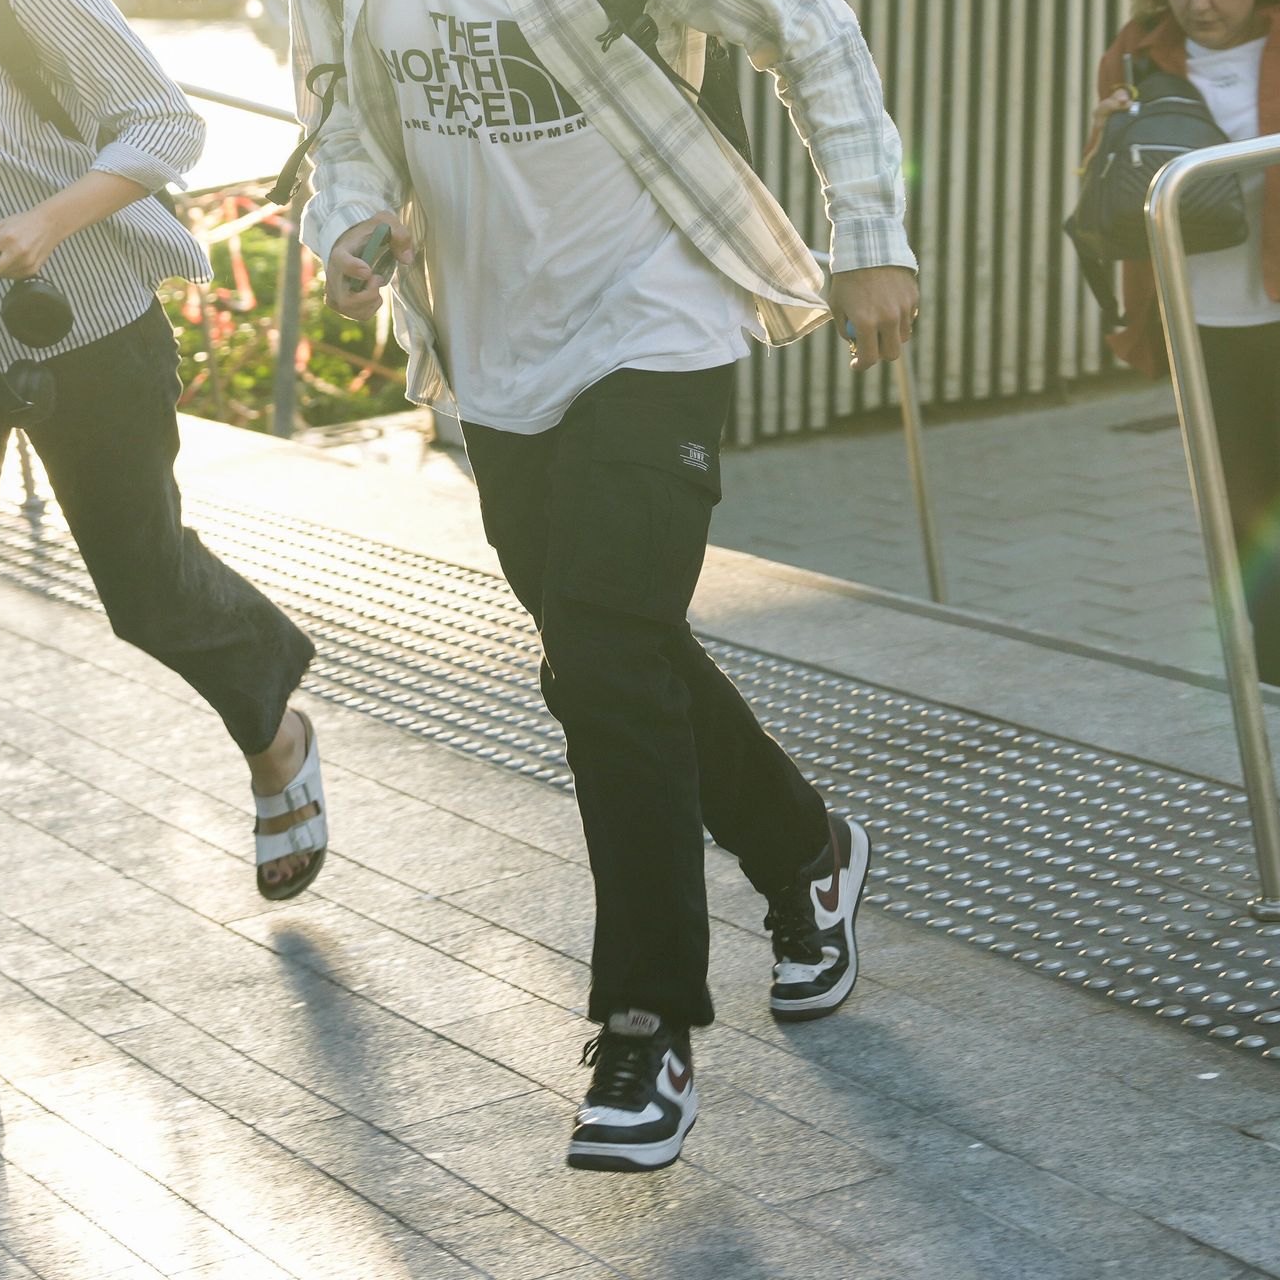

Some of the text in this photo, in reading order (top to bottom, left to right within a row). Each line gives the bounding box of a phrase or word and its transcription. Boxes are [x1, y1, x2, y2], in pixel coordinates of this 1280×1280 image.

[429, 10, 495, 57] THE
[422, 83, 511, 129] FACE
[404, 118, 431, 131] INE
[489, 116, 588, 144] EQUIPMEN
